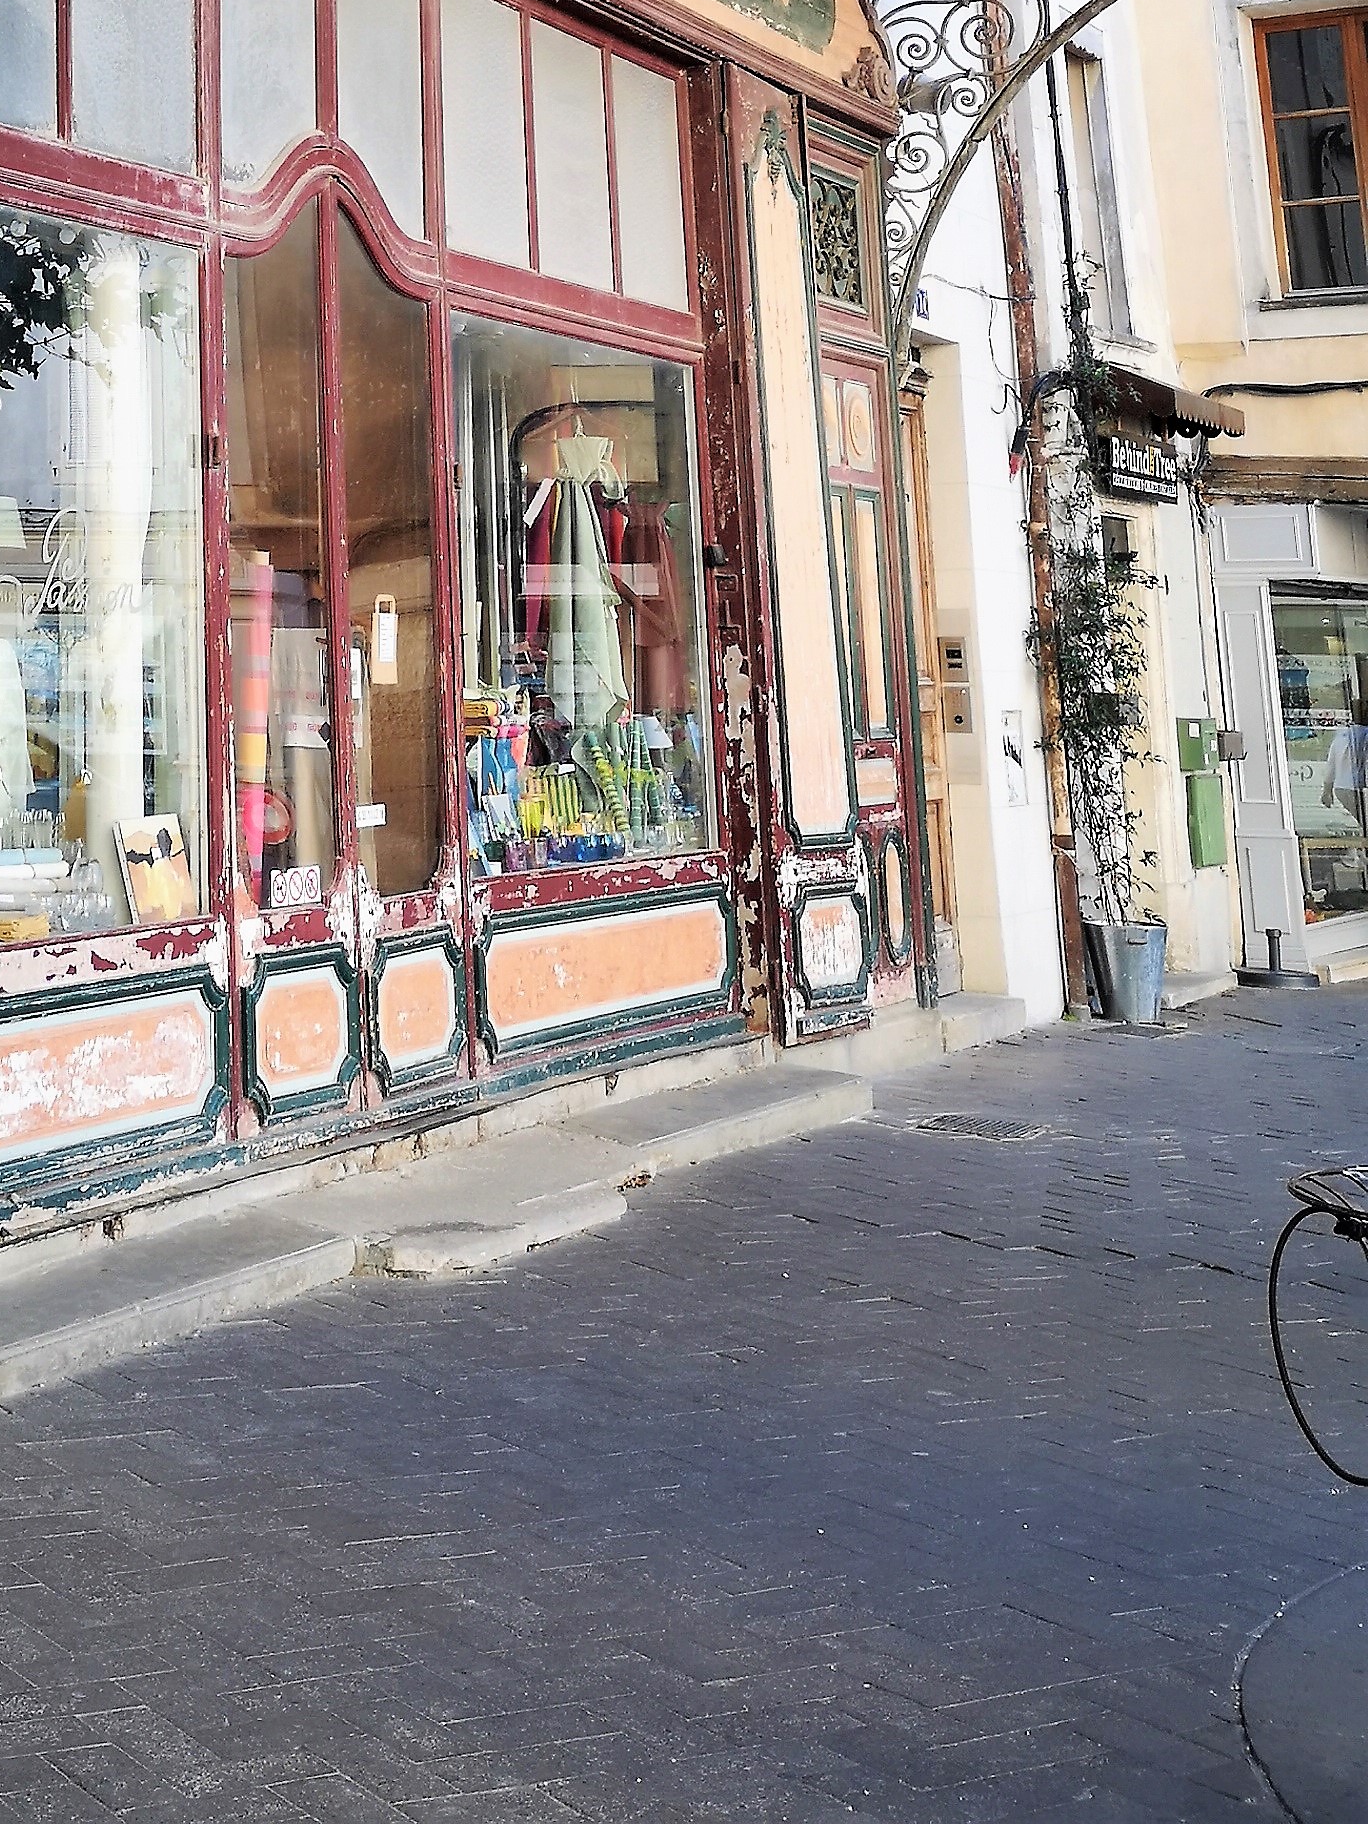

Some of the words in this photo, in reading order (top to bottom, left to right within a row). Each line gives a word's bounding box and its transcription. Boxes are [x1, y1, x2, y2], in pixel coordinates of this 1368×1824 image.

[1112, 436, 1151, 477] Behind
[1153, 447, 1177, 482] Tree
[22, 507, 157, 626] Passon
